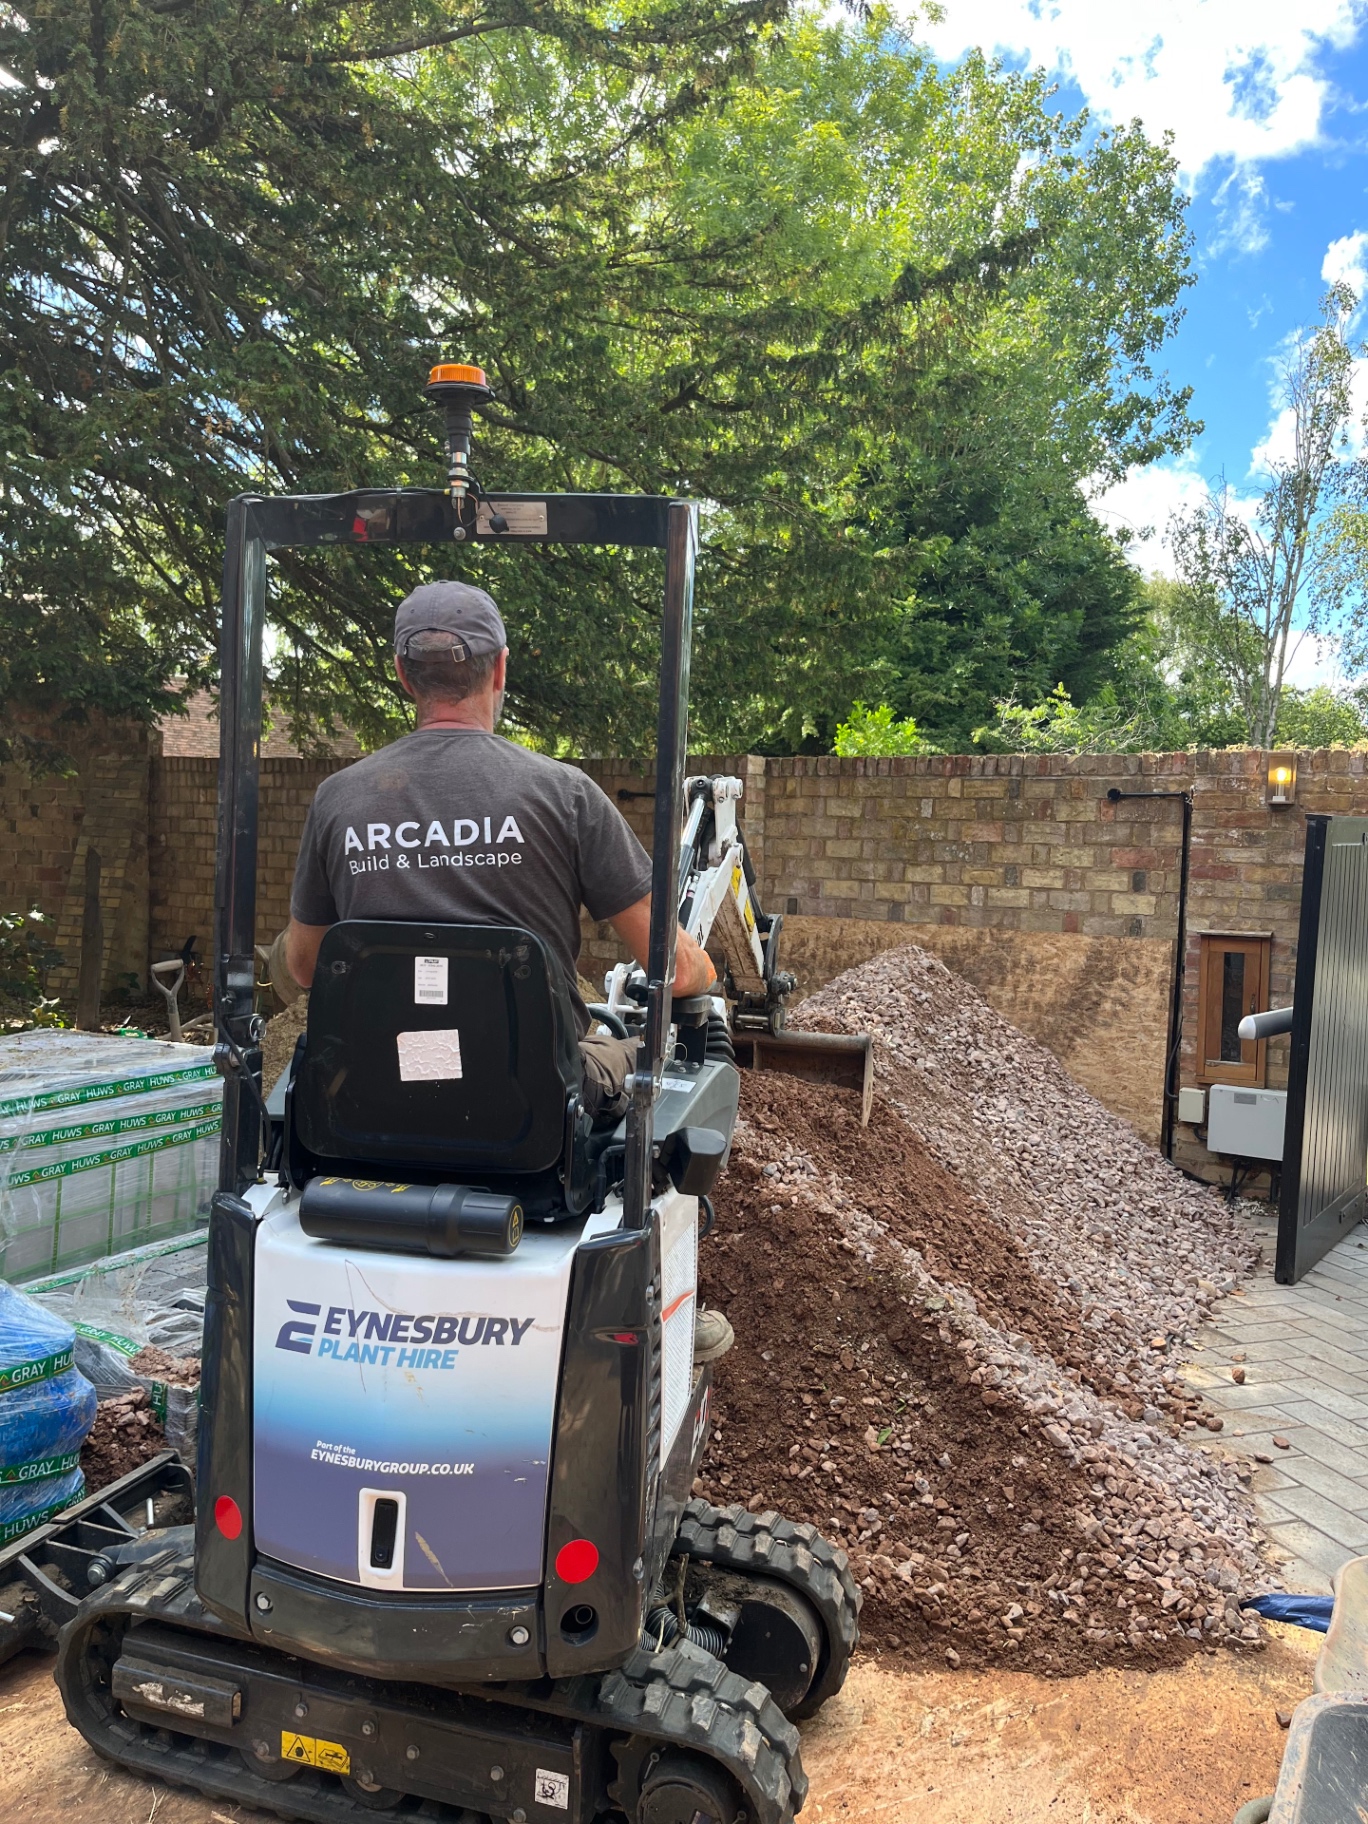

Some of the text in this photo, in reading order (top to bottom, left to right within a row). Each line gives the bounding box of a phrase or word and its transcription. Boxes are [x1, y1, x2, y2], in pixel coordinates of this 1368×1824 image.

[344, 815, 525, 855] ARCADIA
[349, 851, 522, 875] Build & Landscape
[16, 1097, 48, 1112] HUWS
[57, 1092, 81, 1104] GRAY
[86, 1085, 115, 1098] HUWS
[123, 1080, 145, 1092] GRAY
[150, 1074, 175, 1087] HUWS
[182, 1069, 201, 1080] GRAY
[205, 1066, 217, 1077] HU
[21, 1133, 47, 1146] GRAY
[52, 1127, 83, 1141] HUWS
[92, 1122, 116, 1134] GRAY
[120, 1116, 147, 1129] HUWS
[155, 1112, 177, 1123] GRAY
[180, 1107, 204, 1119] HUWS
[211, 1103, 223, 1113] GR
[8, 1121, 219, 1185] UWS GRAY HUWS GRAY HUWS GRAY HUWS
[323, 1306, 536, 1346] EYNESBURY
[110, 1335, 140, 1354] HUW
[318, 1338, 459, 1370] PLANT HIRE
[12, 1352, 74, 1383] GRAY HU
[153, 1383, 163, 1406] HU
[310, 1448, 475, 1475] EYNESBURYGROUP.CO.UK
[316, 1440, 356, 1455] Part of the
[19, 1461, 54, 1480] GRAY
[5, 1510, 49, 1539] HUWS
